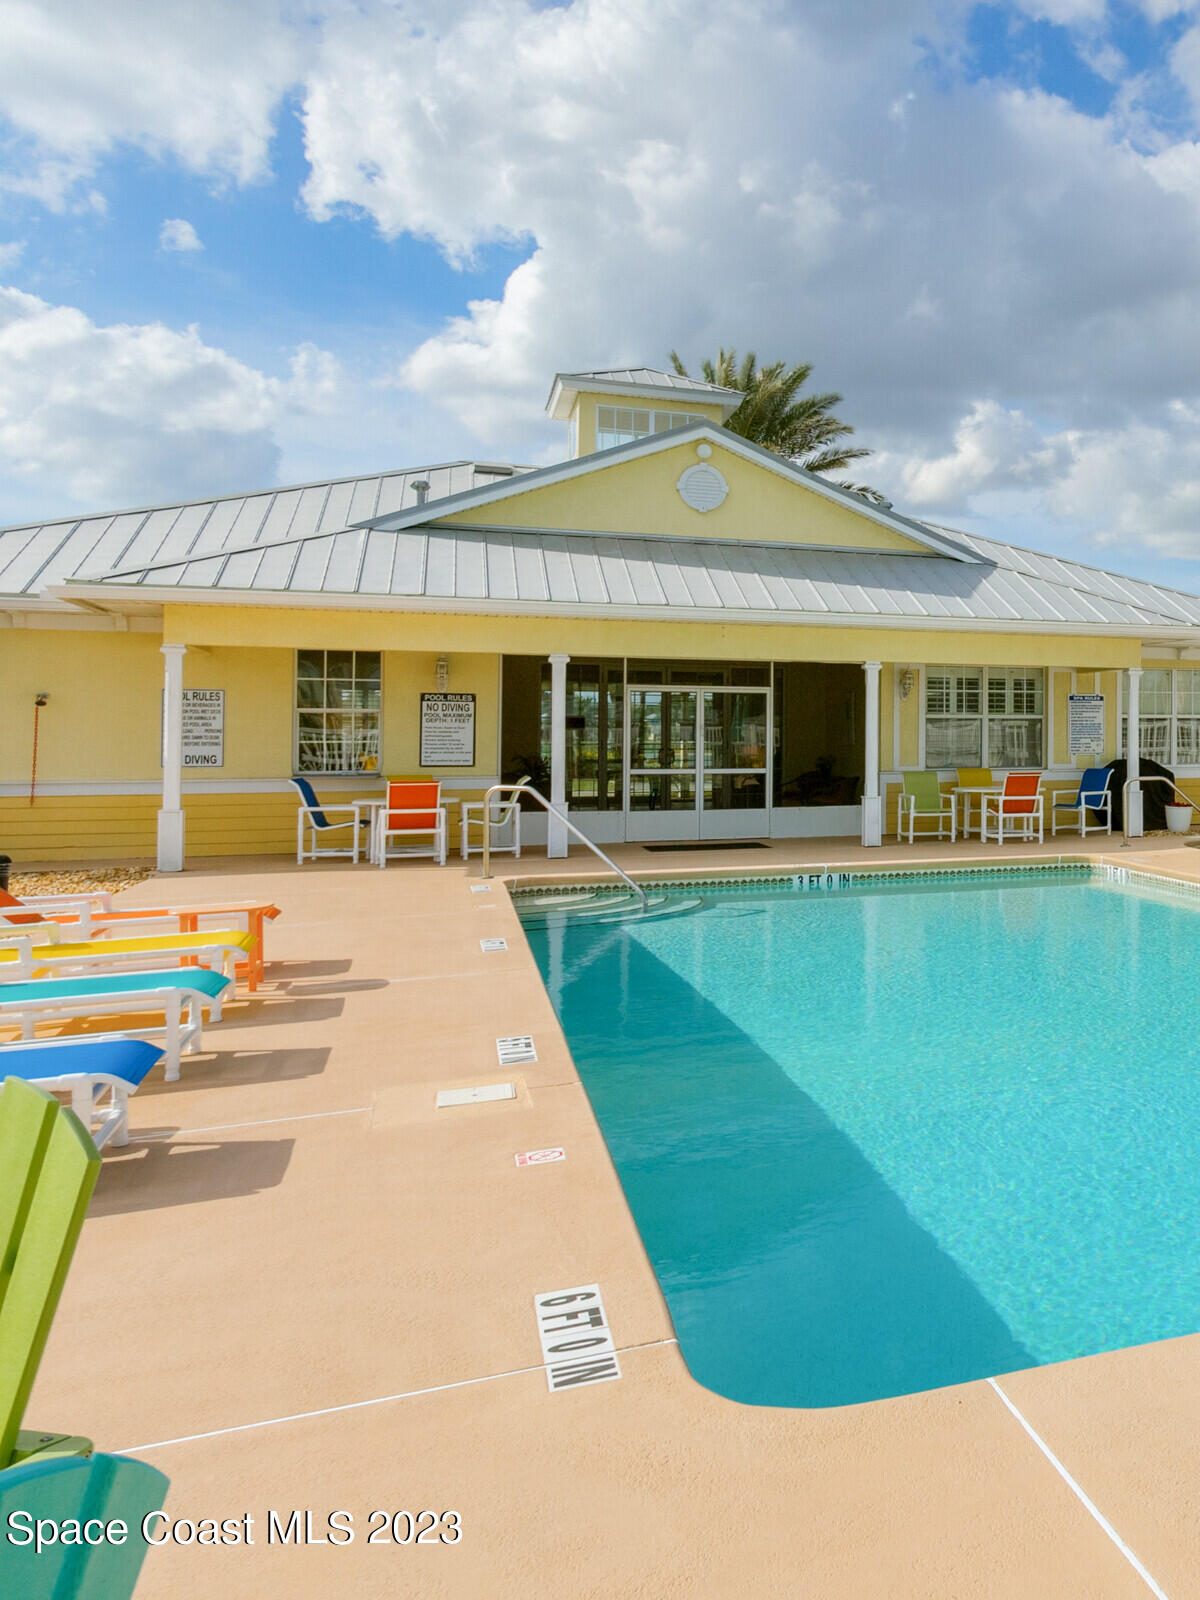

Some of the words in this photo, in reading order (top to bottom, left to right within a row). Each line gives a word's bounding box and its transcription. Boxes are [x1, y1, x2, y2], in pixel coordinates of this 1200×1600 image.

[192, 691, 220, 701] RULES
[426, 703, 439, 711] NO
[441, 703, 470, 712] DIVING
[184, 754, 218, 765] DIVING
[797, 875, 804, 884] 3
[808, 874, 822, 885] FT
[826, 874, 833, 884] 0
[838, 873, 850, 884] IN
[540, 1292, 596, 1307] 6
[542, 1307, 604, 1333] FT
[547, 1337, 608, 1353] 0
[551, 1357, 619, 1388] IN
